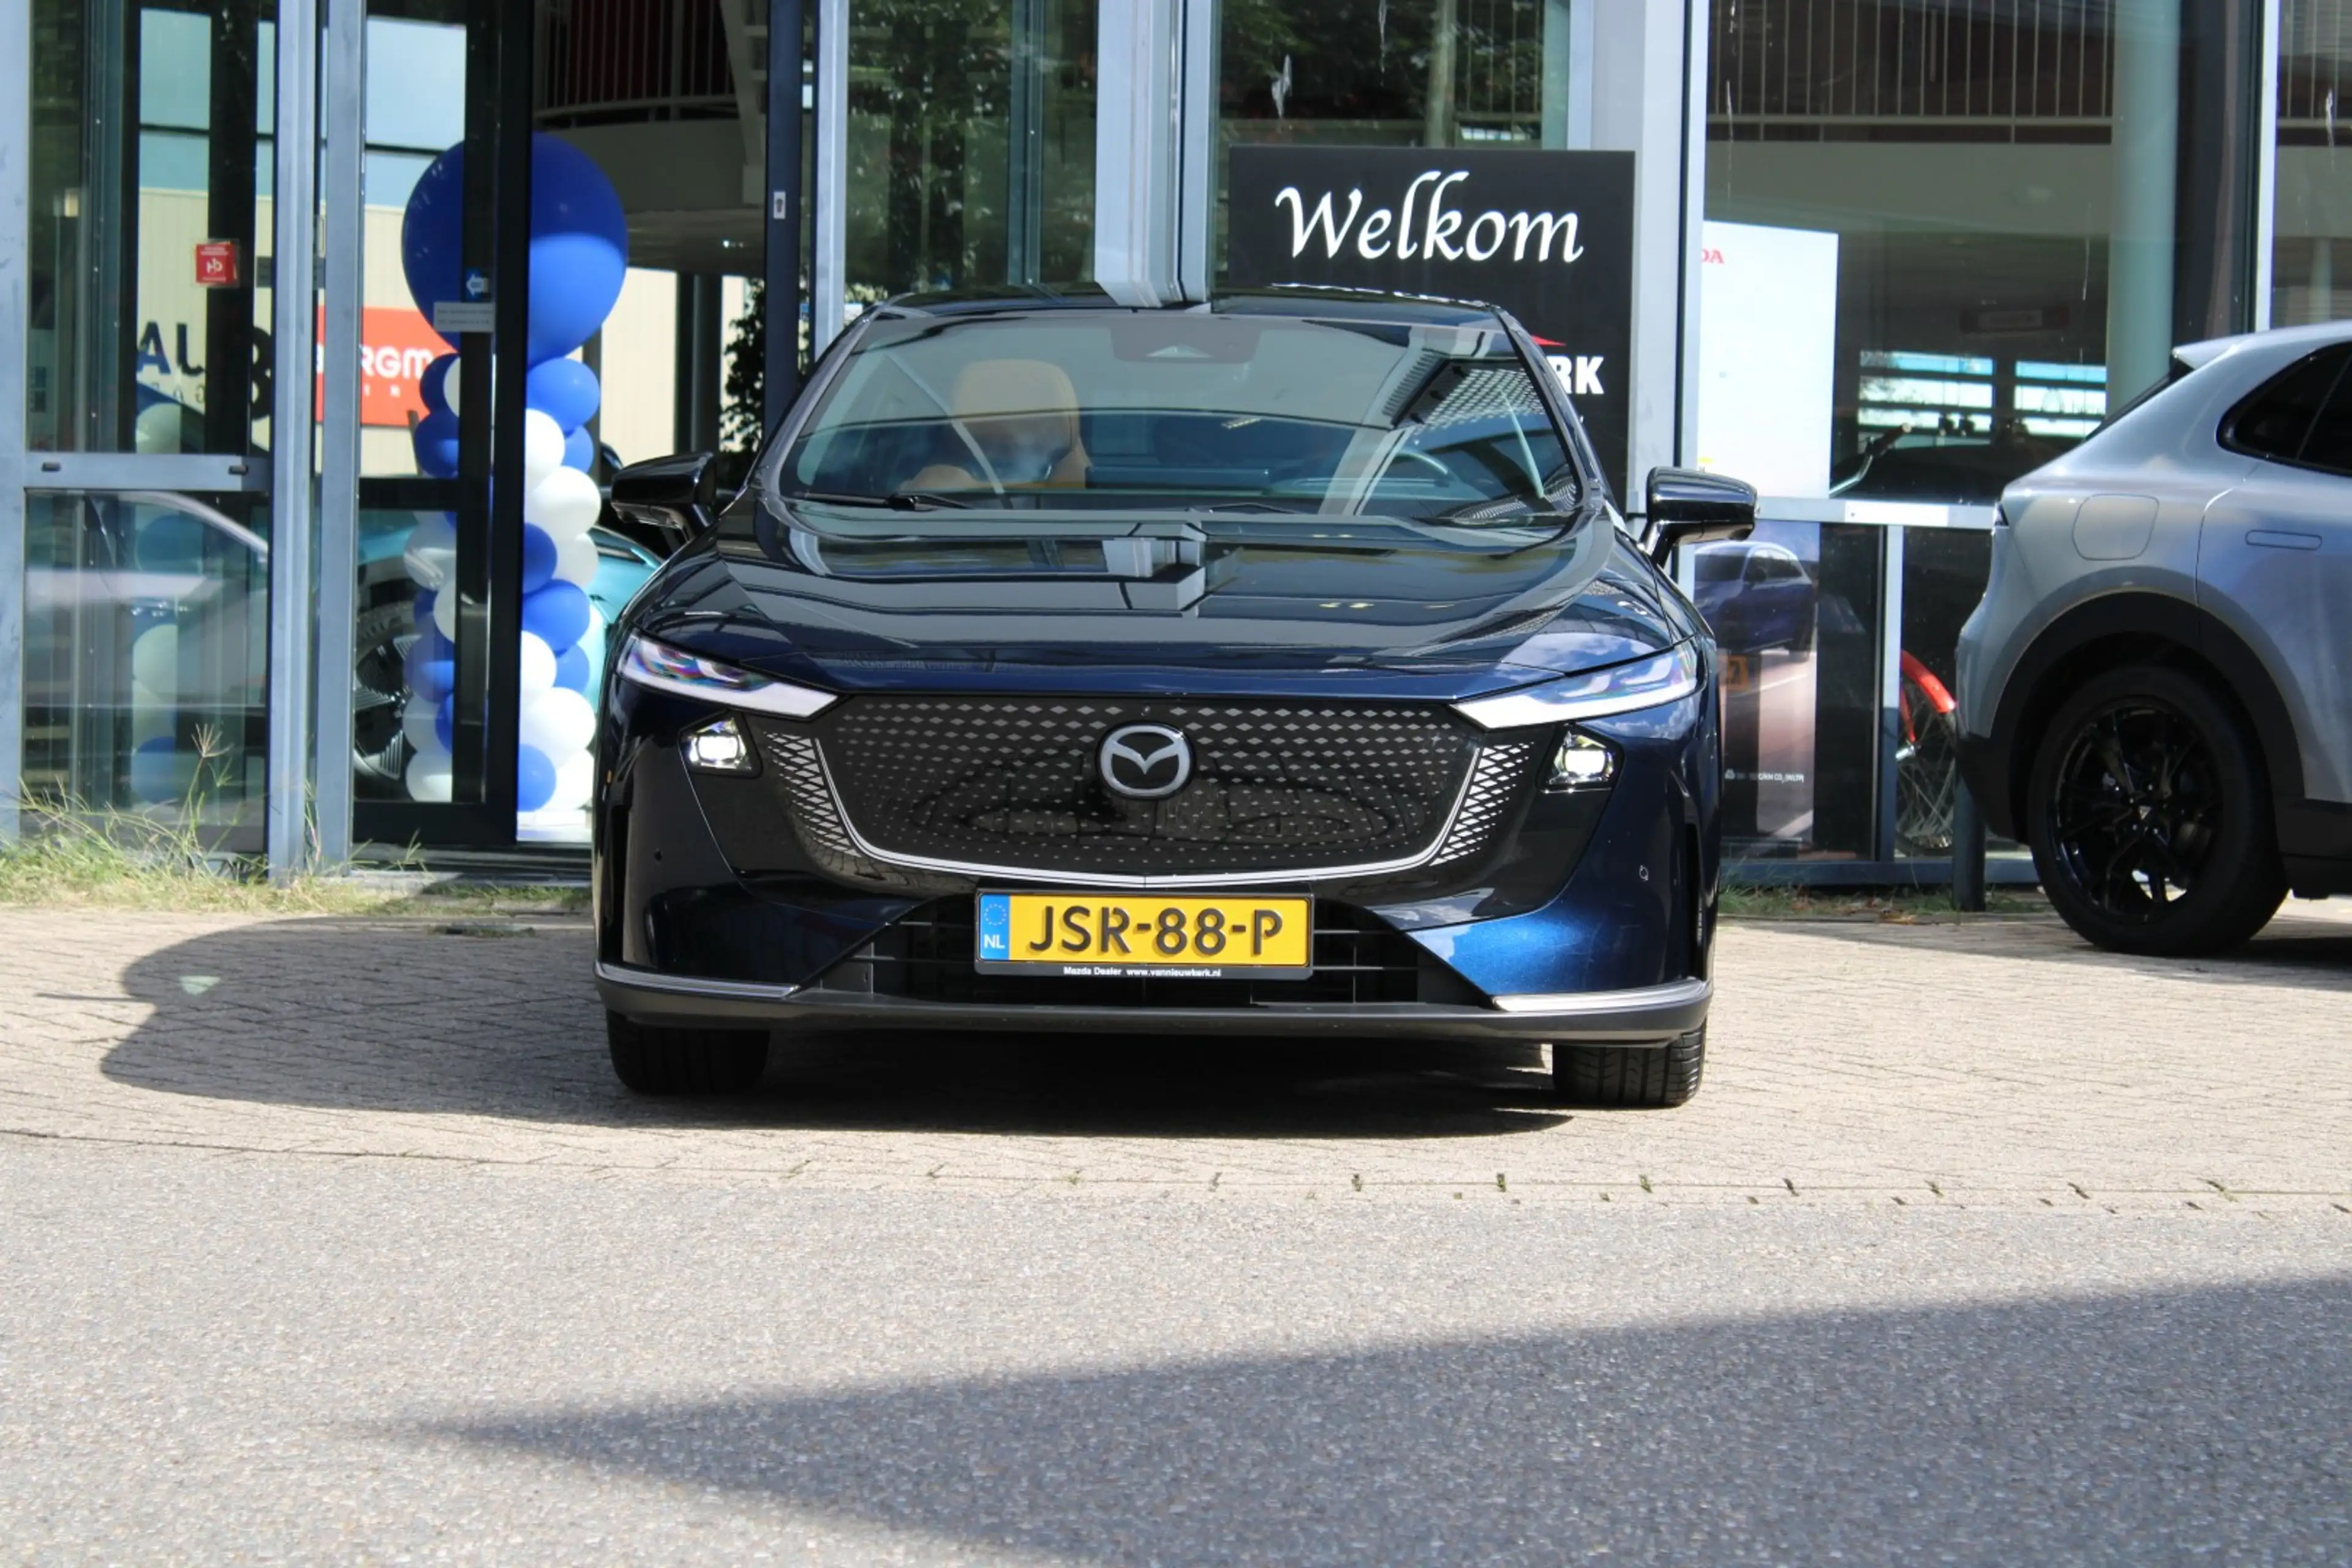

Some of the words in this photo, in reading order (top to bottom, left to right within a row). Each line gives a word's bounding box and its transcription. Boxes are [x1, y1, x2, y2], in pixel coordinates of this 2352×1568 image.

[1275, 170, 1584, 262] Welkom
[1547, 355, 1605, 394] RK
[984, 934, 1006, 949] NL
[1029, 905, 1284, 956] JSR-88-P
[1063, 966, 1092, 975] Mazda
[1094, 967, 1121, 976] Dealer
[1126, 968, 1221, 977] www.vannieuwkerk.nl
